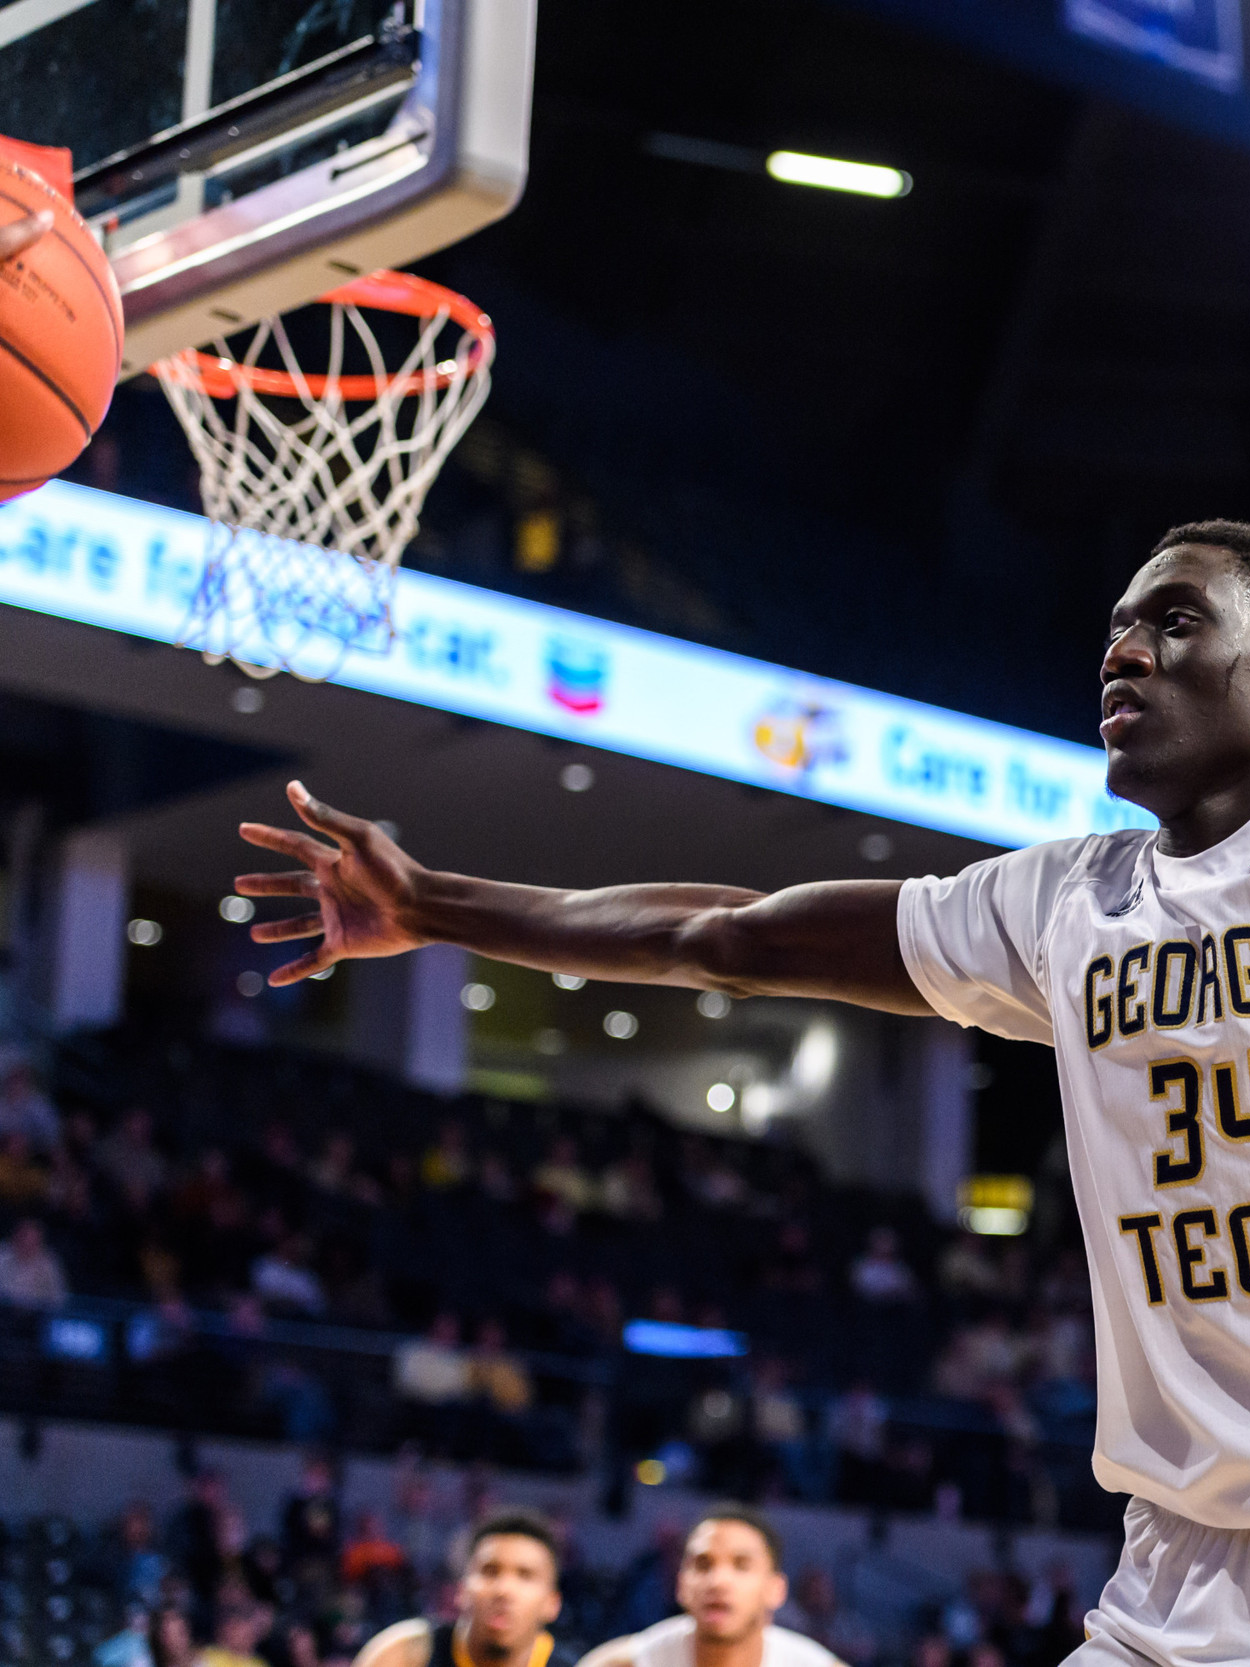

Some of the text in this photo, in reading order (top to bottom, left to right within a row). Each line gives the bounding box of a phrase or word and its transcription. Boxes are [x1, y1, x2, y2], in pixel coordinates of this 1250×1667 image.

[0, 514, 118, 592] are
[882, 722, 988, 806] Care
[1006, 754, 1070, 822] for
